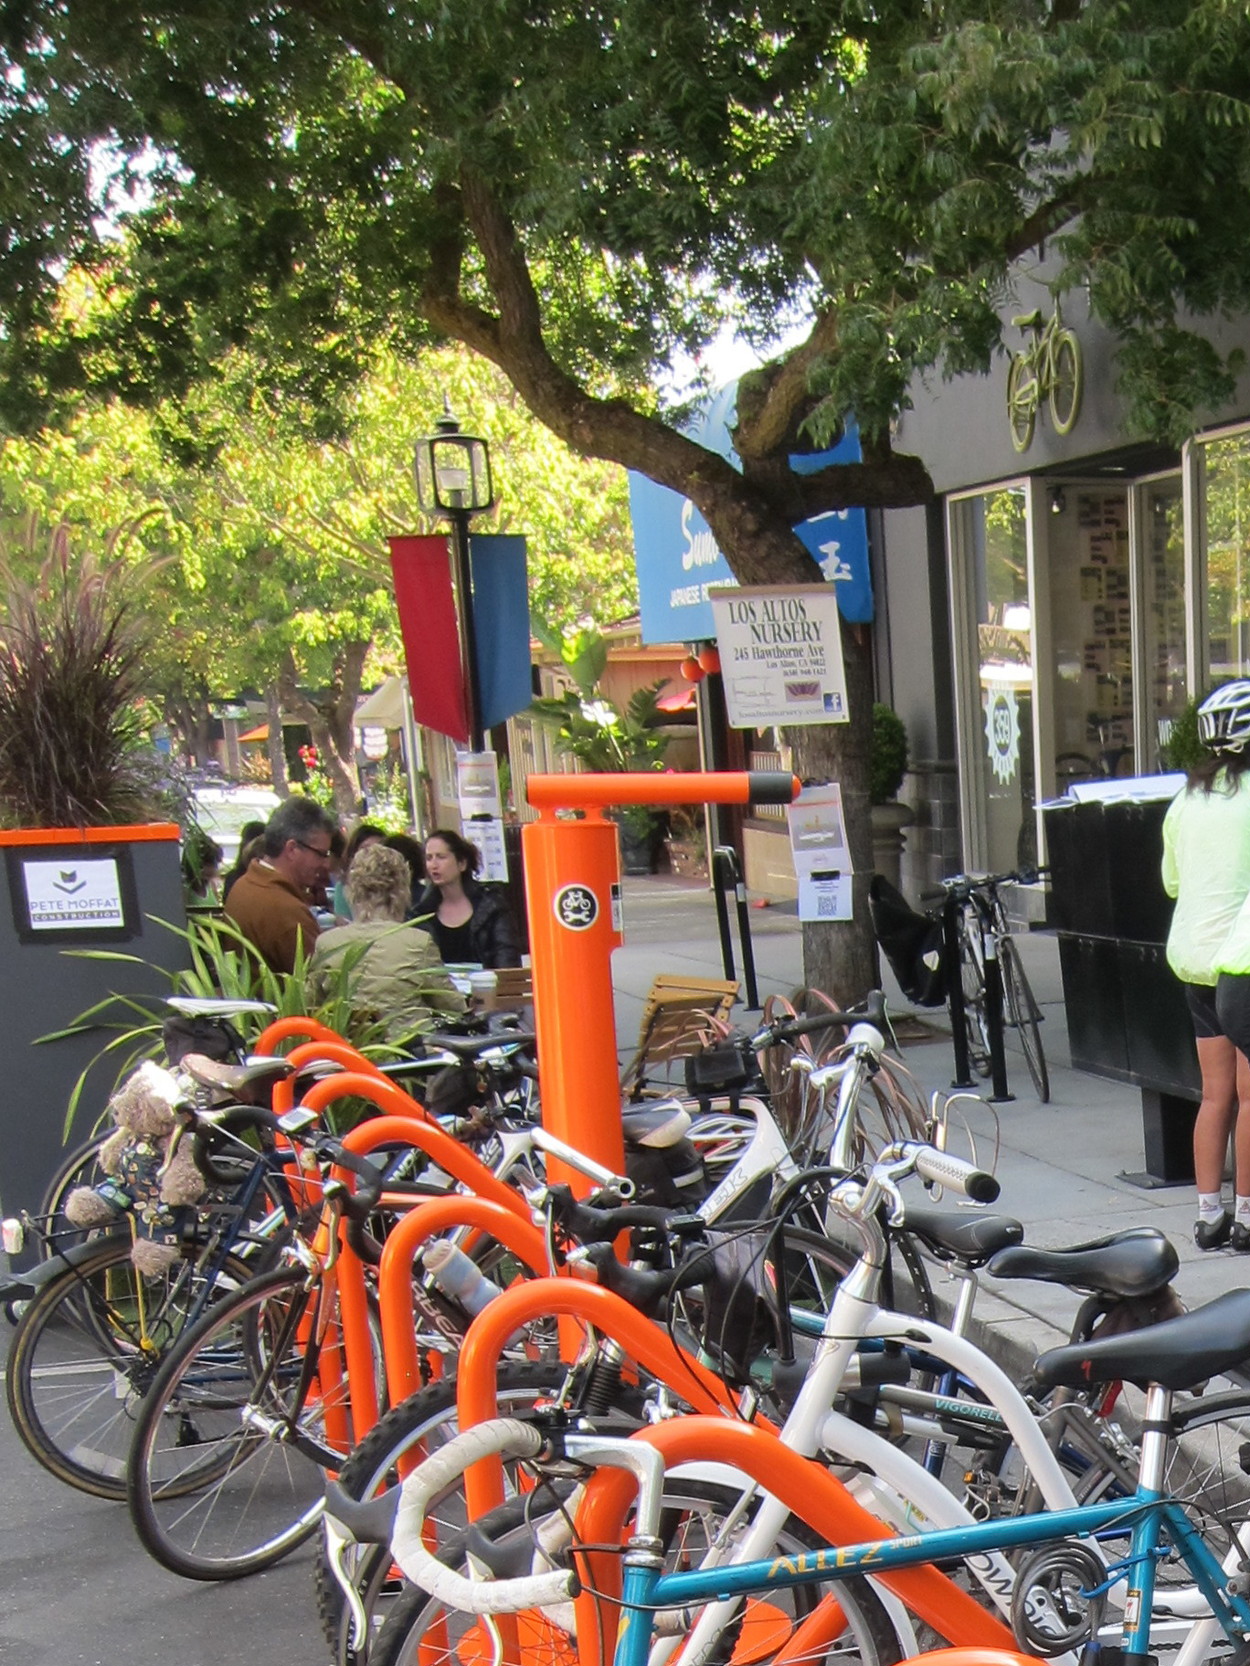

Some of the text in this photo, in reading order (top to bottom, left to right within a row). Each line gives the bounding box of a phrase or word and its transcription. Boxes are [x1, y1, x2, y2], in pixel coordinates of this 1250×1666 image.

[728, 599, 807, 624] LOS ALTOS
[751, 621, 822, 644] NURSERY
[734, 644, 825, 661] 245 Hawthorne Ave
[31, 898, 118, 910] PETE MOFFAT
[34, 911, 119, 921] CONSTRUCTION
[935, 1399, 1004, 1422] VIGORELL
[766, 1535, 922, 1579] ALLEZ SPORT
